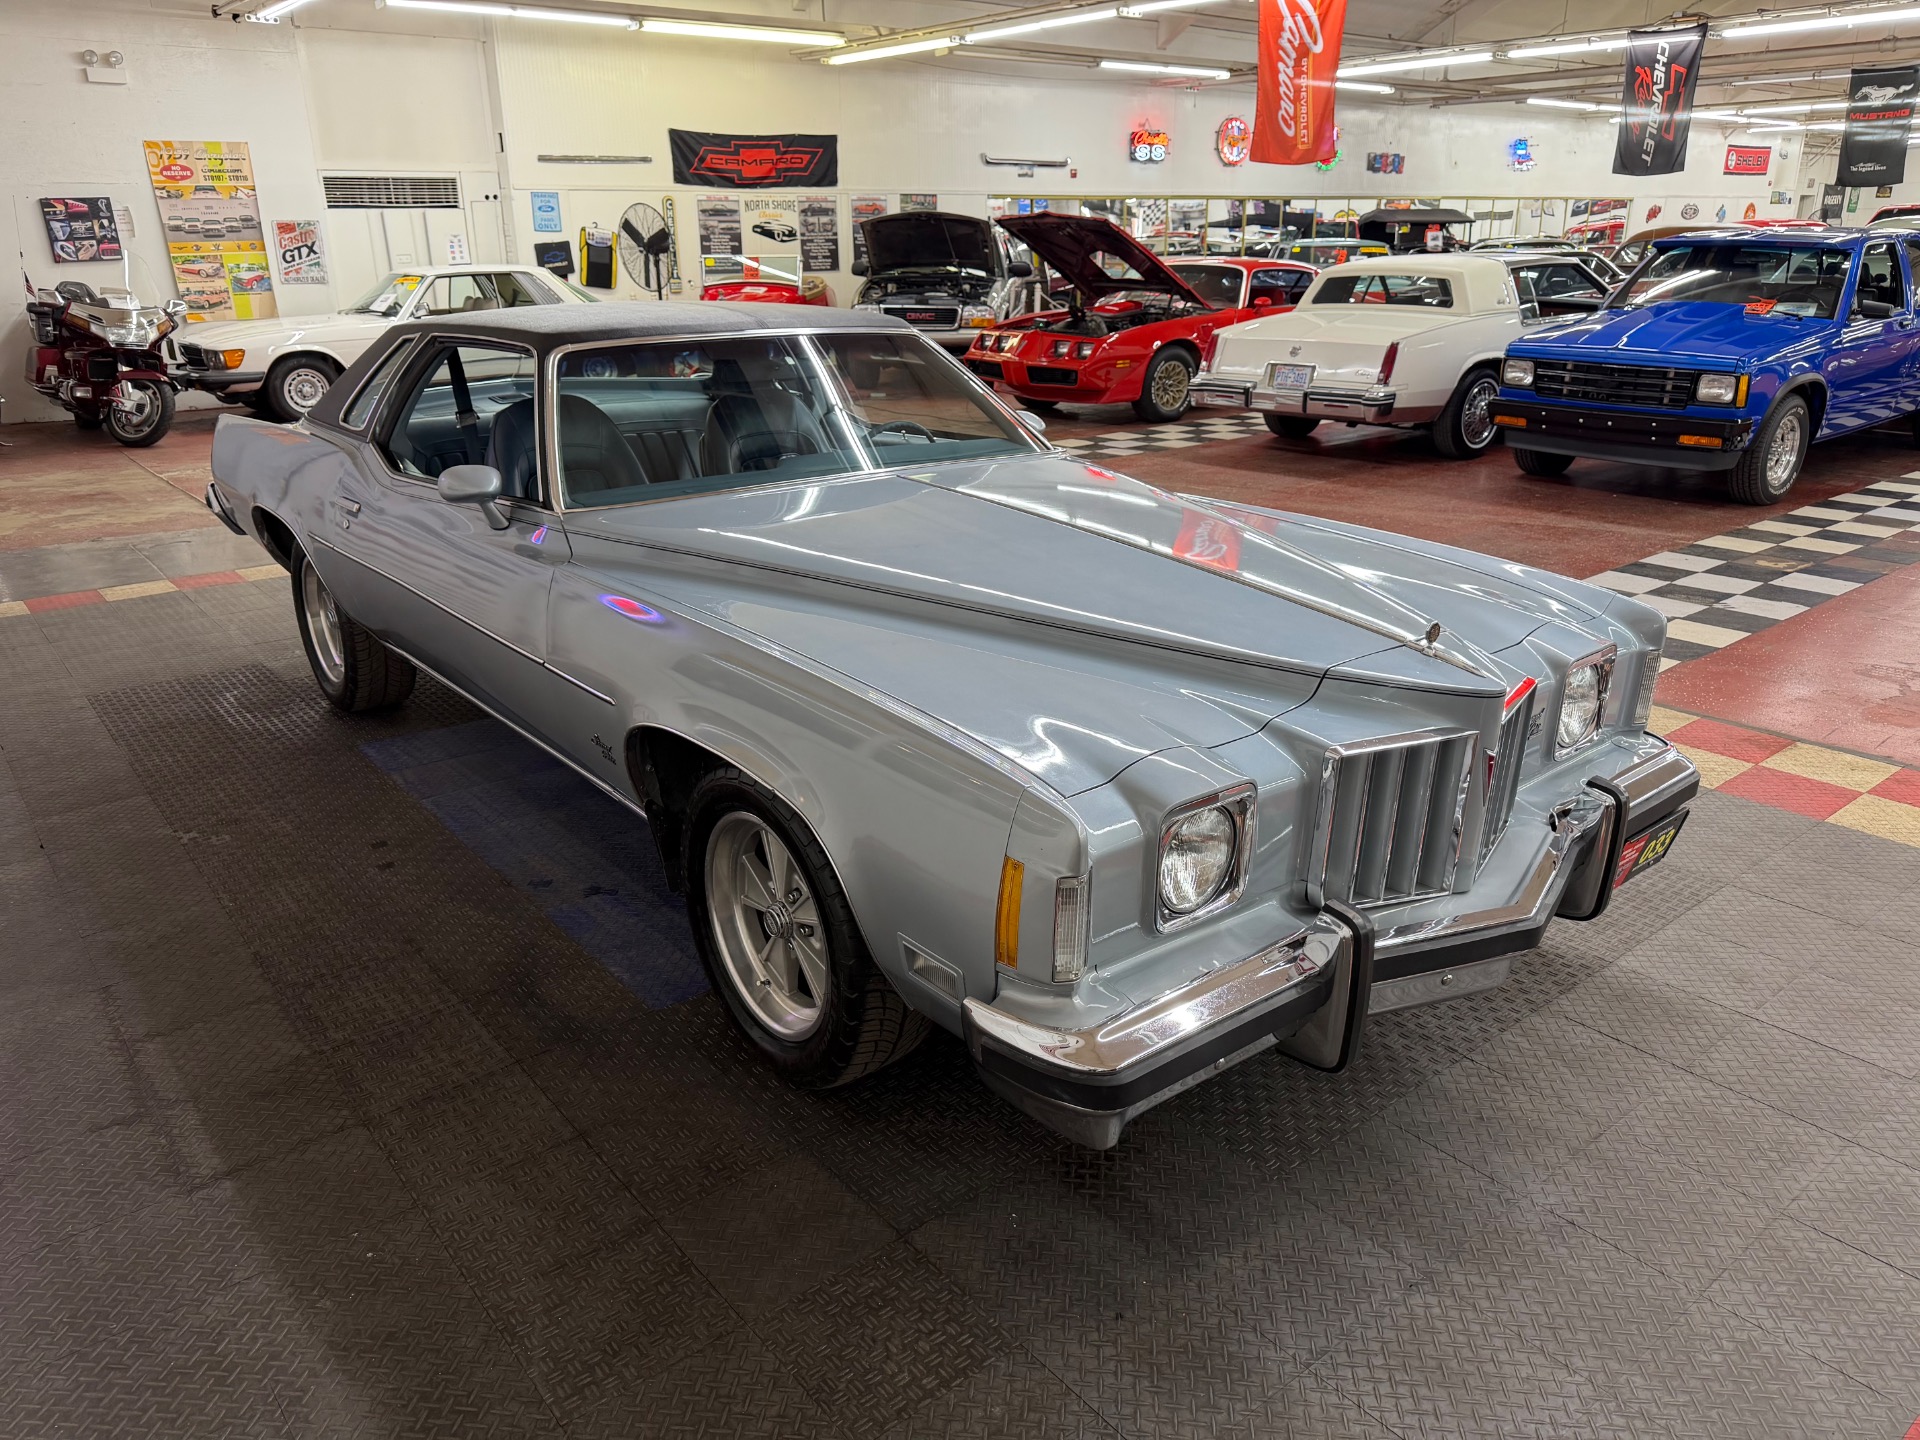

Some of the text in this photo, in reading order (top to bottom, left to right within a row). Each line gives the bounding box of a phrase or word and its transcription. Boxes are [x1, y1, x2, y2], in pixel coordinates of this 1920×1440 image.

[1300, 57, 1308, 143] BY CHEVROLET
[1641, 41, 1669, 166] CHEVROLET
[1849, 108, 1911, 120] MUSTANG
[159, 148, 190, 160] 1959
[1135, 143, 1166, 161] SS
[709, 156, 804, 167] CAMARO
[1736, 155, 1768, 166] SHELBY
[743, 199, 797, 213] NORTH SHORE
[281, 240, 320, 264] GTX
[905, 312, 936, 320] GMC
